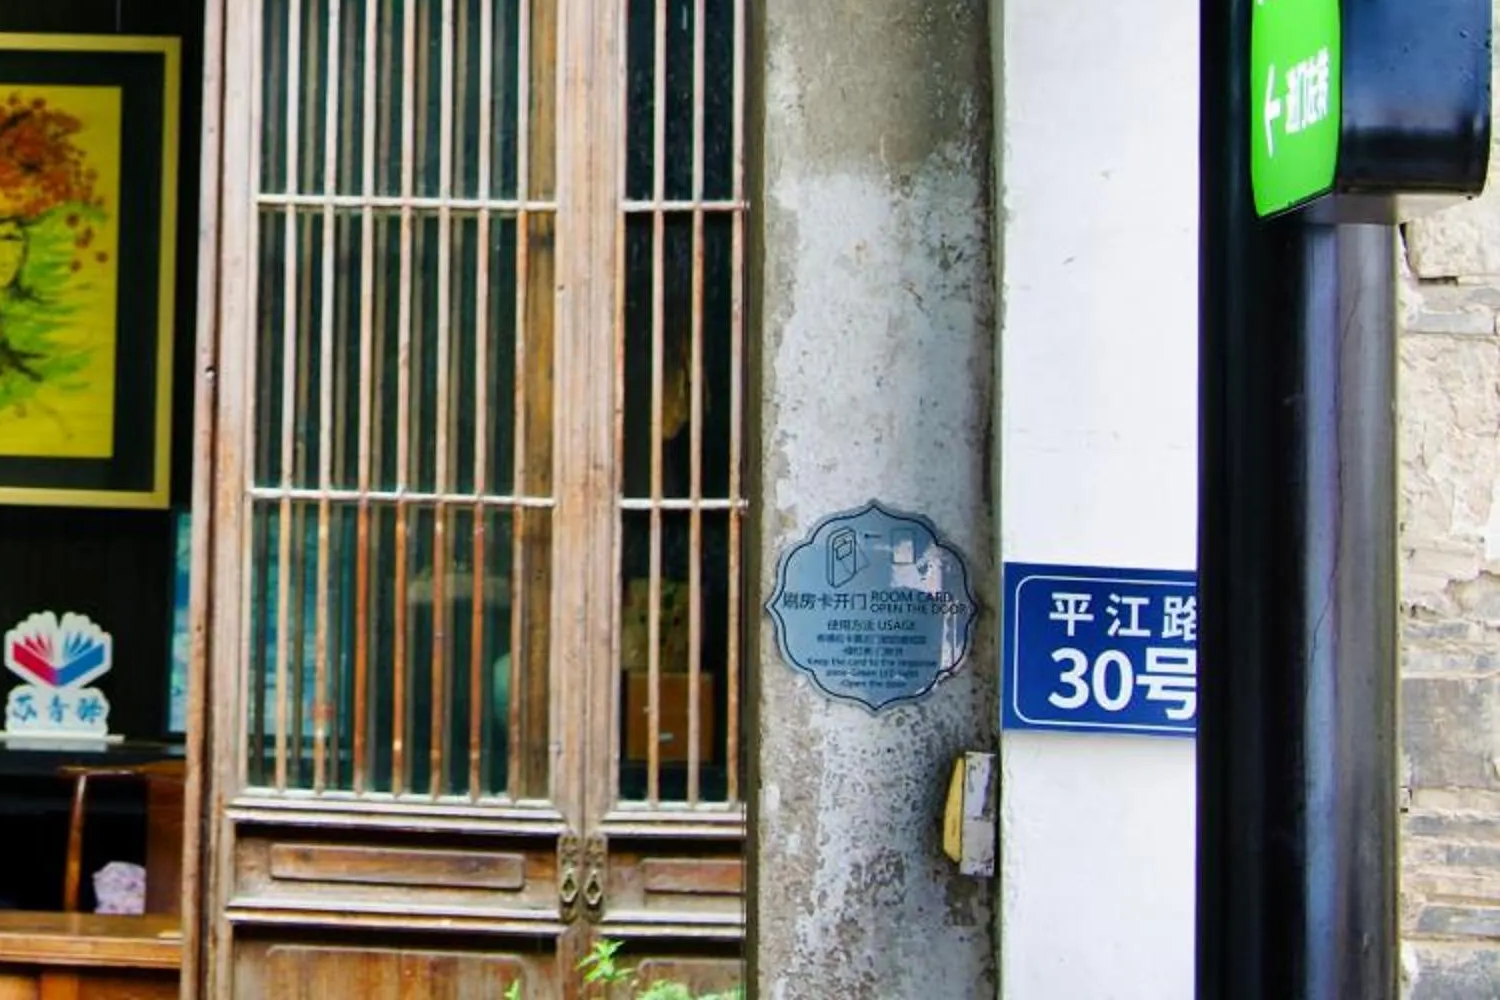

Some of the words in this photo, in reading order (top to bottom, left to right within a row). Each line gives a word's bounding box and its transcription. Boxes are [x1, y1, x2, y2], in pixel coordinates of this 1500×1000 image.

[1048, 592, 1197, 641] 平江路
[1048, 647, 1197, 720] 30号
